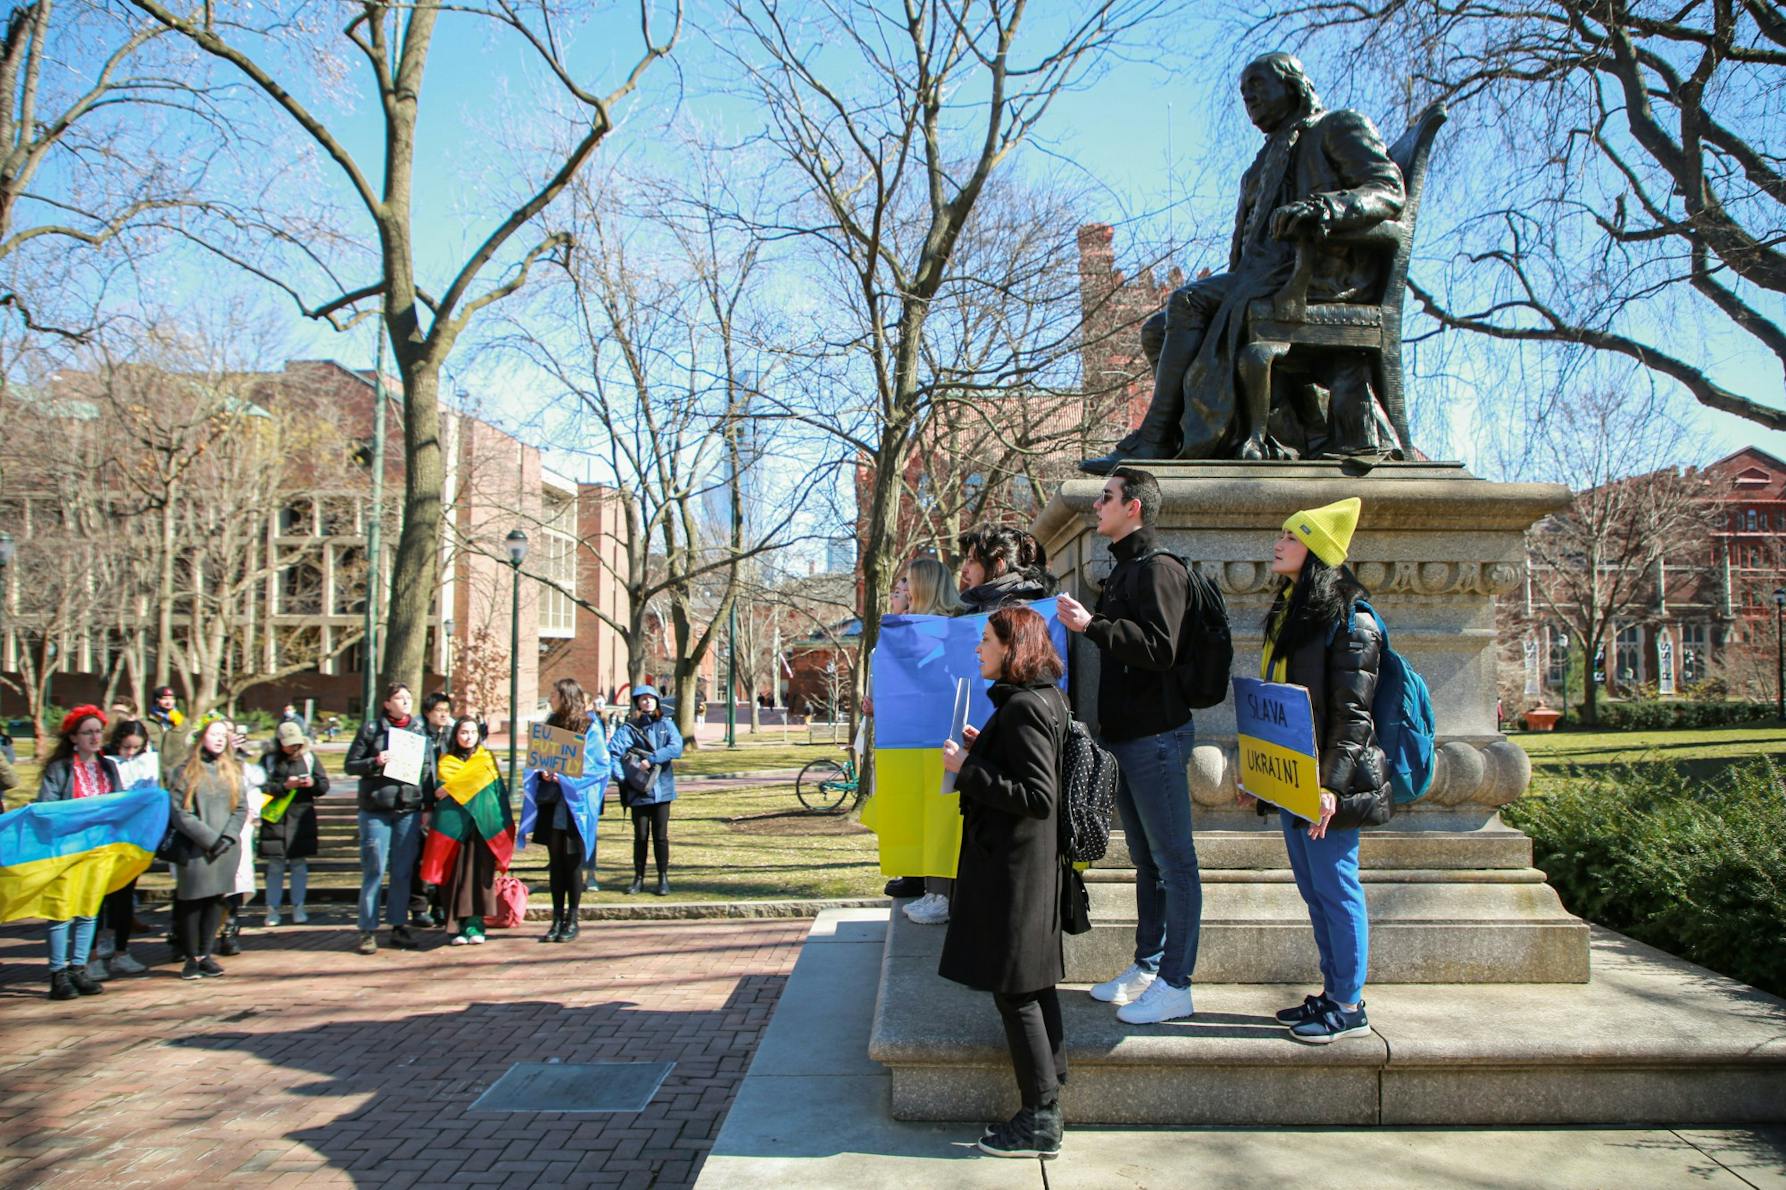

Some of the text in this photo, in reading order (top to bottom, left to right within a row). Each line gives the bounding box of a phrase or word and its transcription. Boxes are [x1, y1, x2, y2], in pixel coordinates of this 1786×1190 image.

[1248, 694, 1288, 728] SLAVA
[529, 752, 582, 773] SWIFTLY
[1247, 749, 1300, 789] UKRAINI
